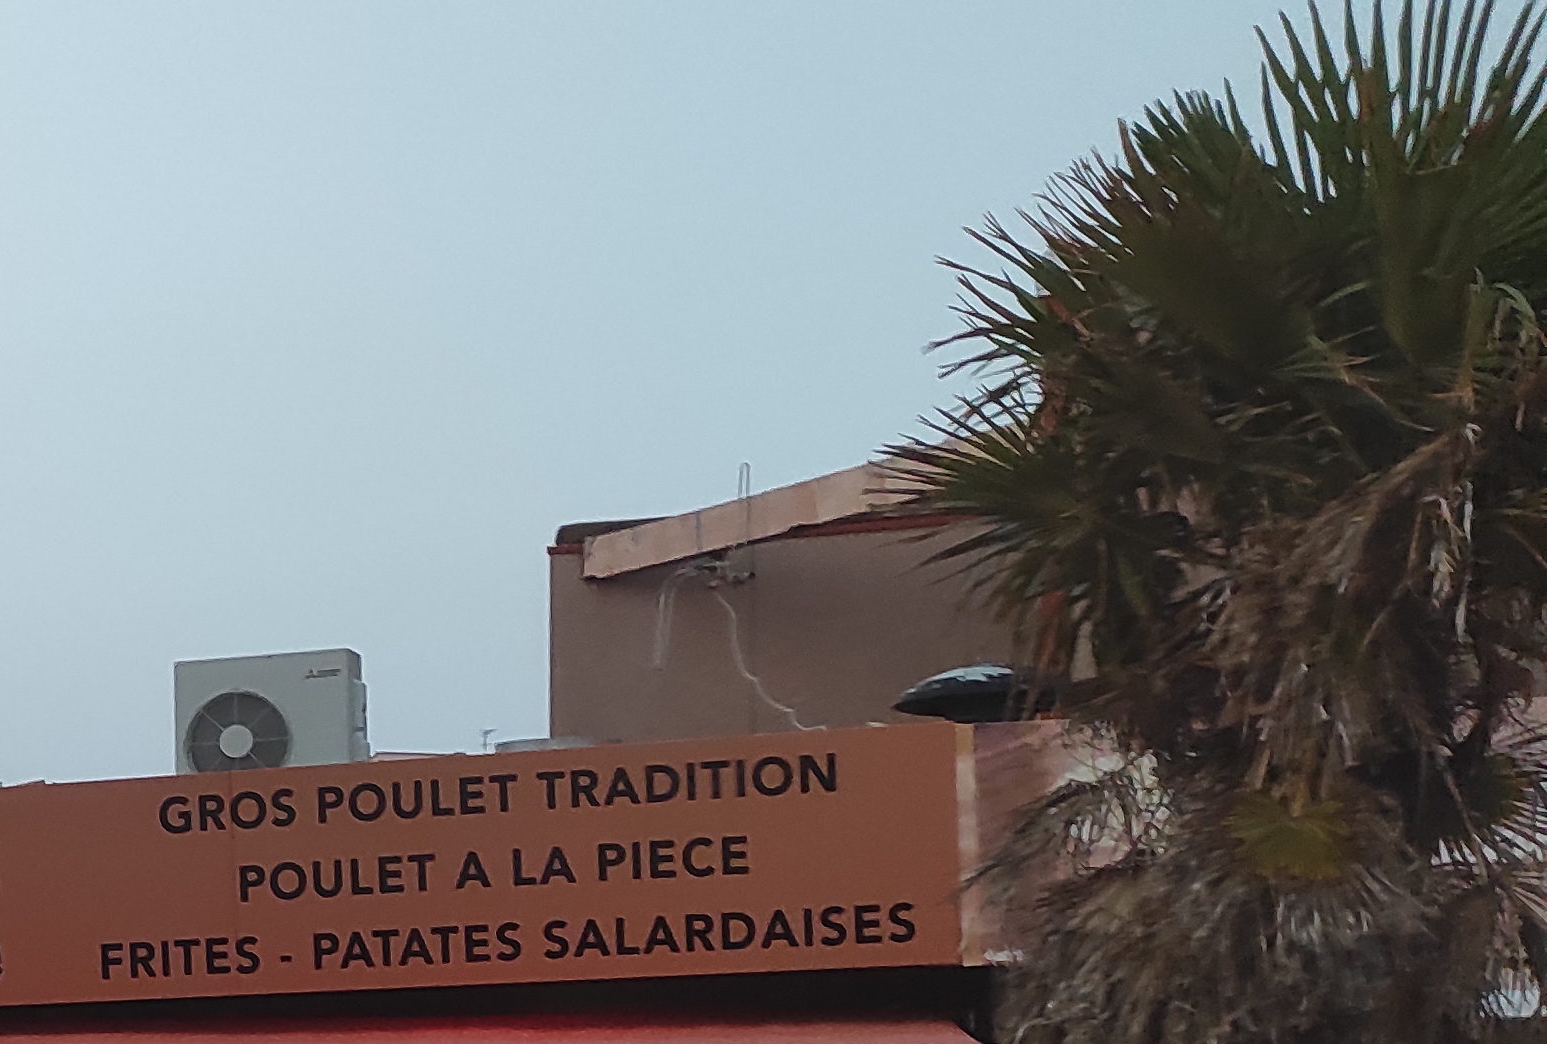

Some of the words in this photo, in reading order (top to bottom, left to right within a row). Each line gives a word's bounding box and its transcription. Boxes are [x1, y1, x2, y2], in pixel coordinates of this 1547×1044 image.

[159, 788, 296, 834] GROS
[318, 773, 518, 824] POULET
[537, 752, 839, 811] TRADITION
[238, 854, 436, 903] POULET
[457, 851, 491, 888] A
[513, 846, 576, 885] LA
[598, 835, 750, 883] PIECE
[100, 934, 261, 980] FRITES
[313, 921, 522, 971] PATATES
[543, 902, 917, 960] SALARDAISES
